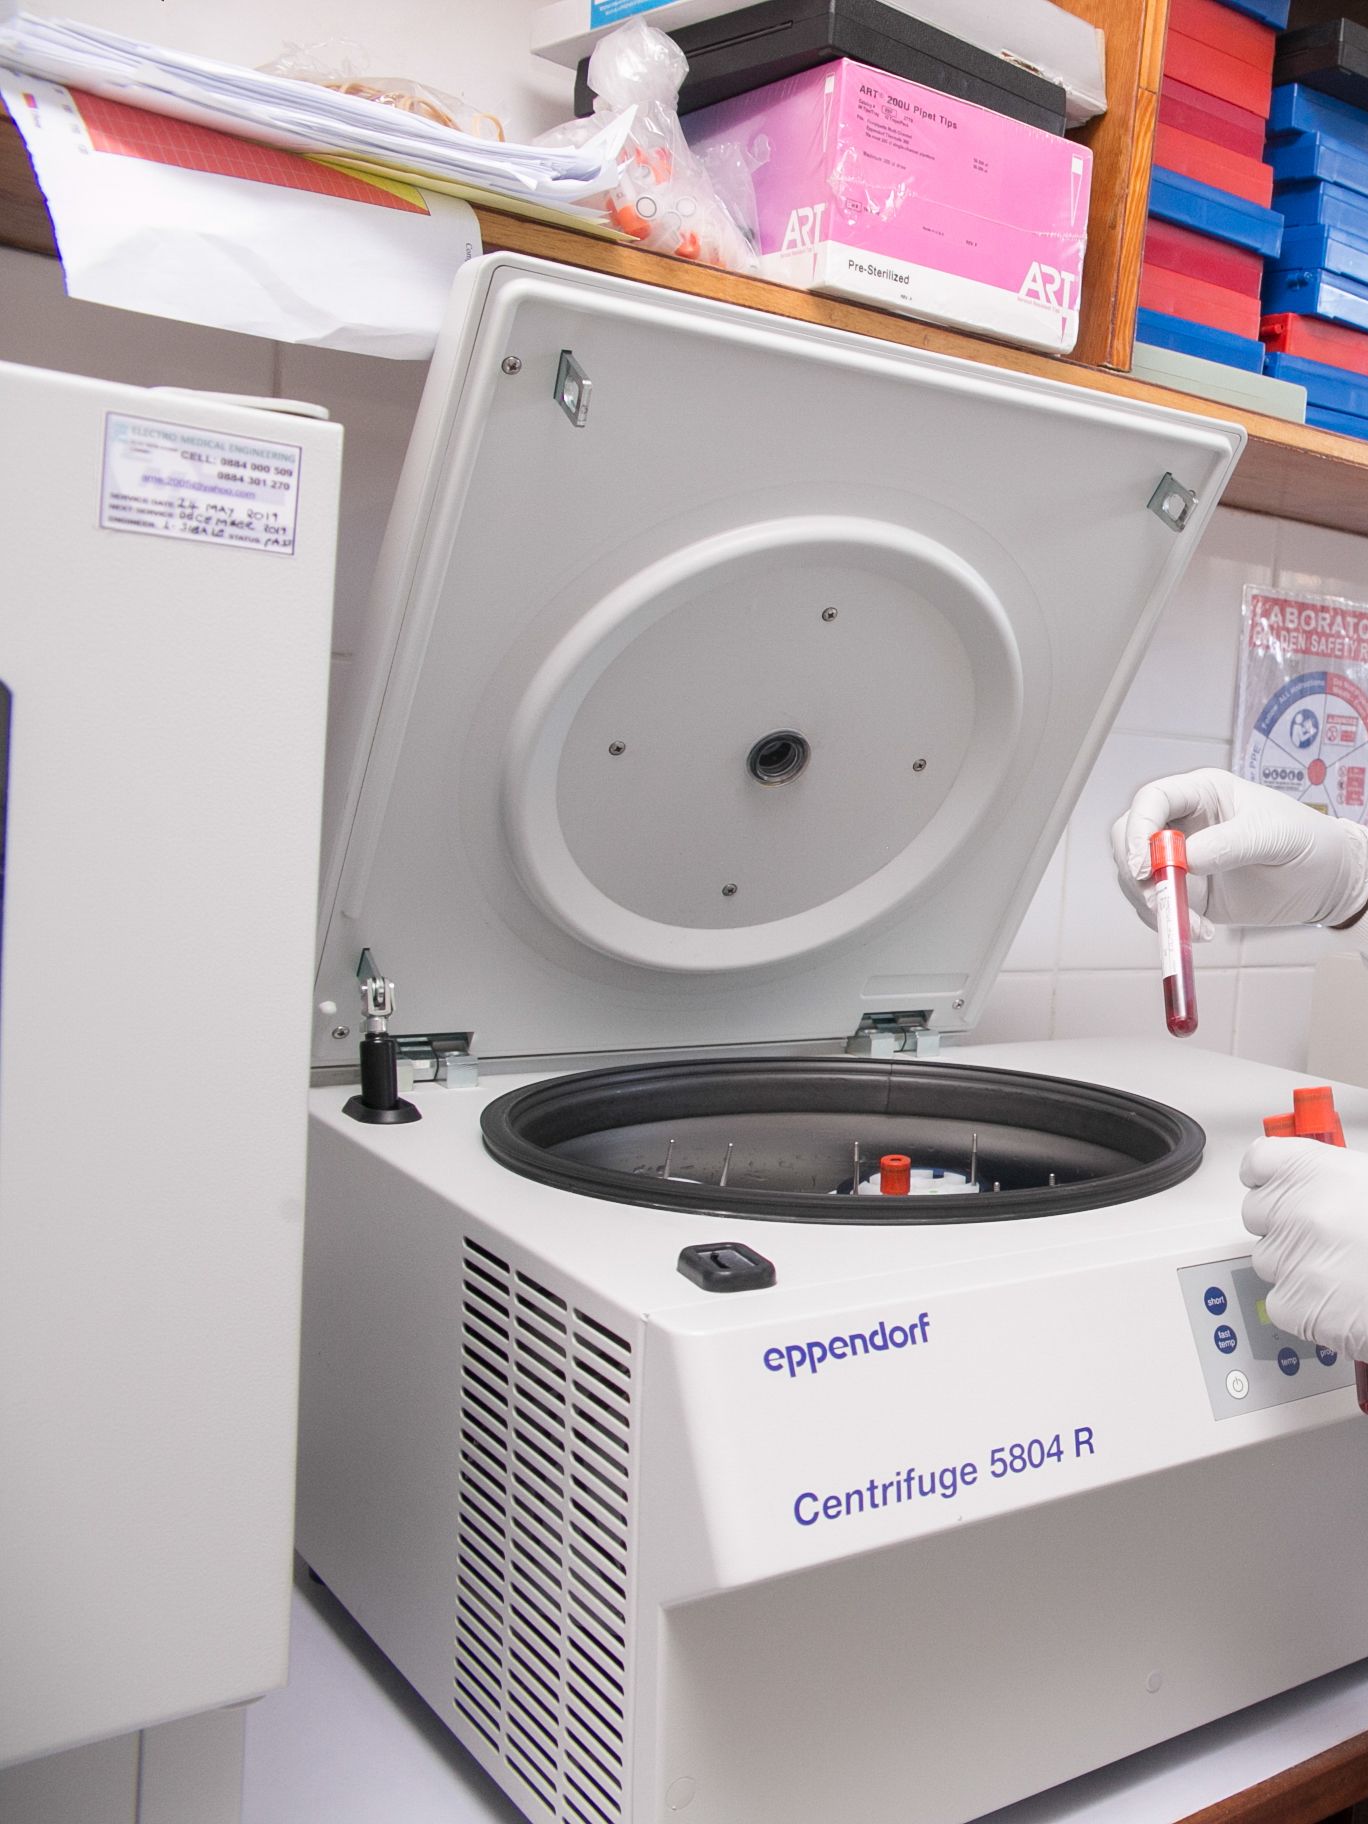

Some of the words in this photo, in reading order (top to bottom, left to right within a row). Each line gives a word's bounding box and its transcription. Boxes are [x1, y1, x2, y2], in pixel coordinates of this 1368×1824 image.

[887, 95, 911, 112] 200U
[913, 105, 937, 121] Pipet
[939, 114, 958, 129] Tips
[781, 202, 826, 253] ART
[848, 259, 910, 285] Pre-Sterilized
[1018, 260, 1076, 314] ART
[130, 426, 178, 442] ELECTRO
[180, 434, 226, 450] MEDICAL
[228, 444, 297, 464] ENGINEERING
[180, 450, 217, 464] CELL:
[205, 503, 235, 518] MAY
[246, 508, 279, 521] 2019
[1252, 627, 1307, 651] GOLDEN
[1311, 633, 1358, 657] SAFETY
[1249, 743, 1262, 769] PPE
[1207, 1295, 1225, 1307] short
[763, 1311, 931, 1378] eppendorf
[1217, 1329, 1231, 1339] fast
[1218, 1338, 1236, 1349] temp
[1280, 1356, 1298, 1367] temp
[792, 1458, 979, 1527] Centrifuge
[989, 1432, 1065, 1479] 5804
[1074, 1426, 1096, 1459] R
